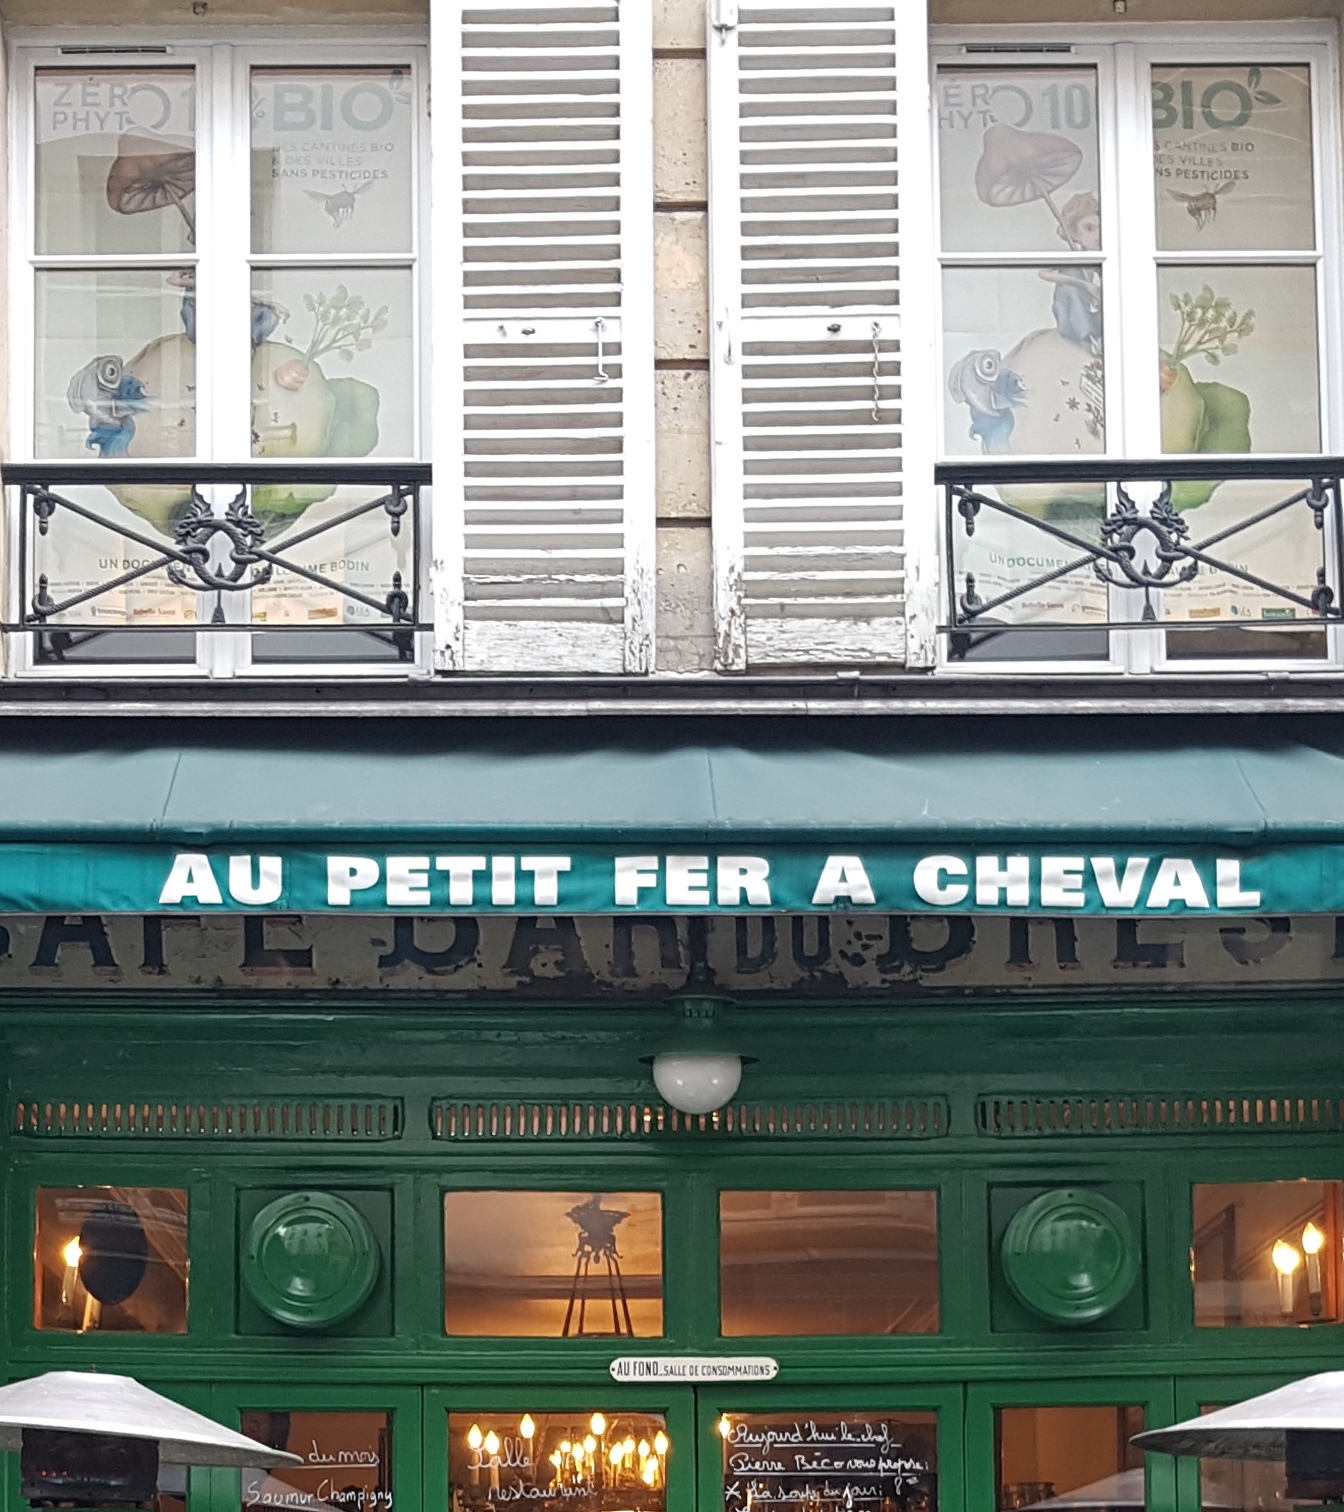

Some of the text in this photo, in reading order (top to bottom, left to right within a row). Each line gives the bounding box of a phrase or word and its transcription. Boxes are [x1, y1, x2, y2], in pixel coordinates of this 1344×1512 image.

[273, 83, 394, 132] BIO
[1152, 79, 1253, 132] BIO
[370, 142, 395, 152] BIO
[1231, 142, 1255, 152] BIO
[1179, 155, 1224, 167] VILLES
[272, 168, 389, 180] SANS PESTICIDES
[1175, 169, 1250, 180] PESTICIDES
[159, 854, 1261, 907] AU PETIT FER A CHEVAL
[617, 1361, 630, 1376] AU
[633, 1361, 659, 1377] FOND
[663, 1365, 687, 1377] SALLE
[701, 1364, 771, 1377] CONSOMMATIONS
[246, 1478, 393, 1510] Saumur Champigny
